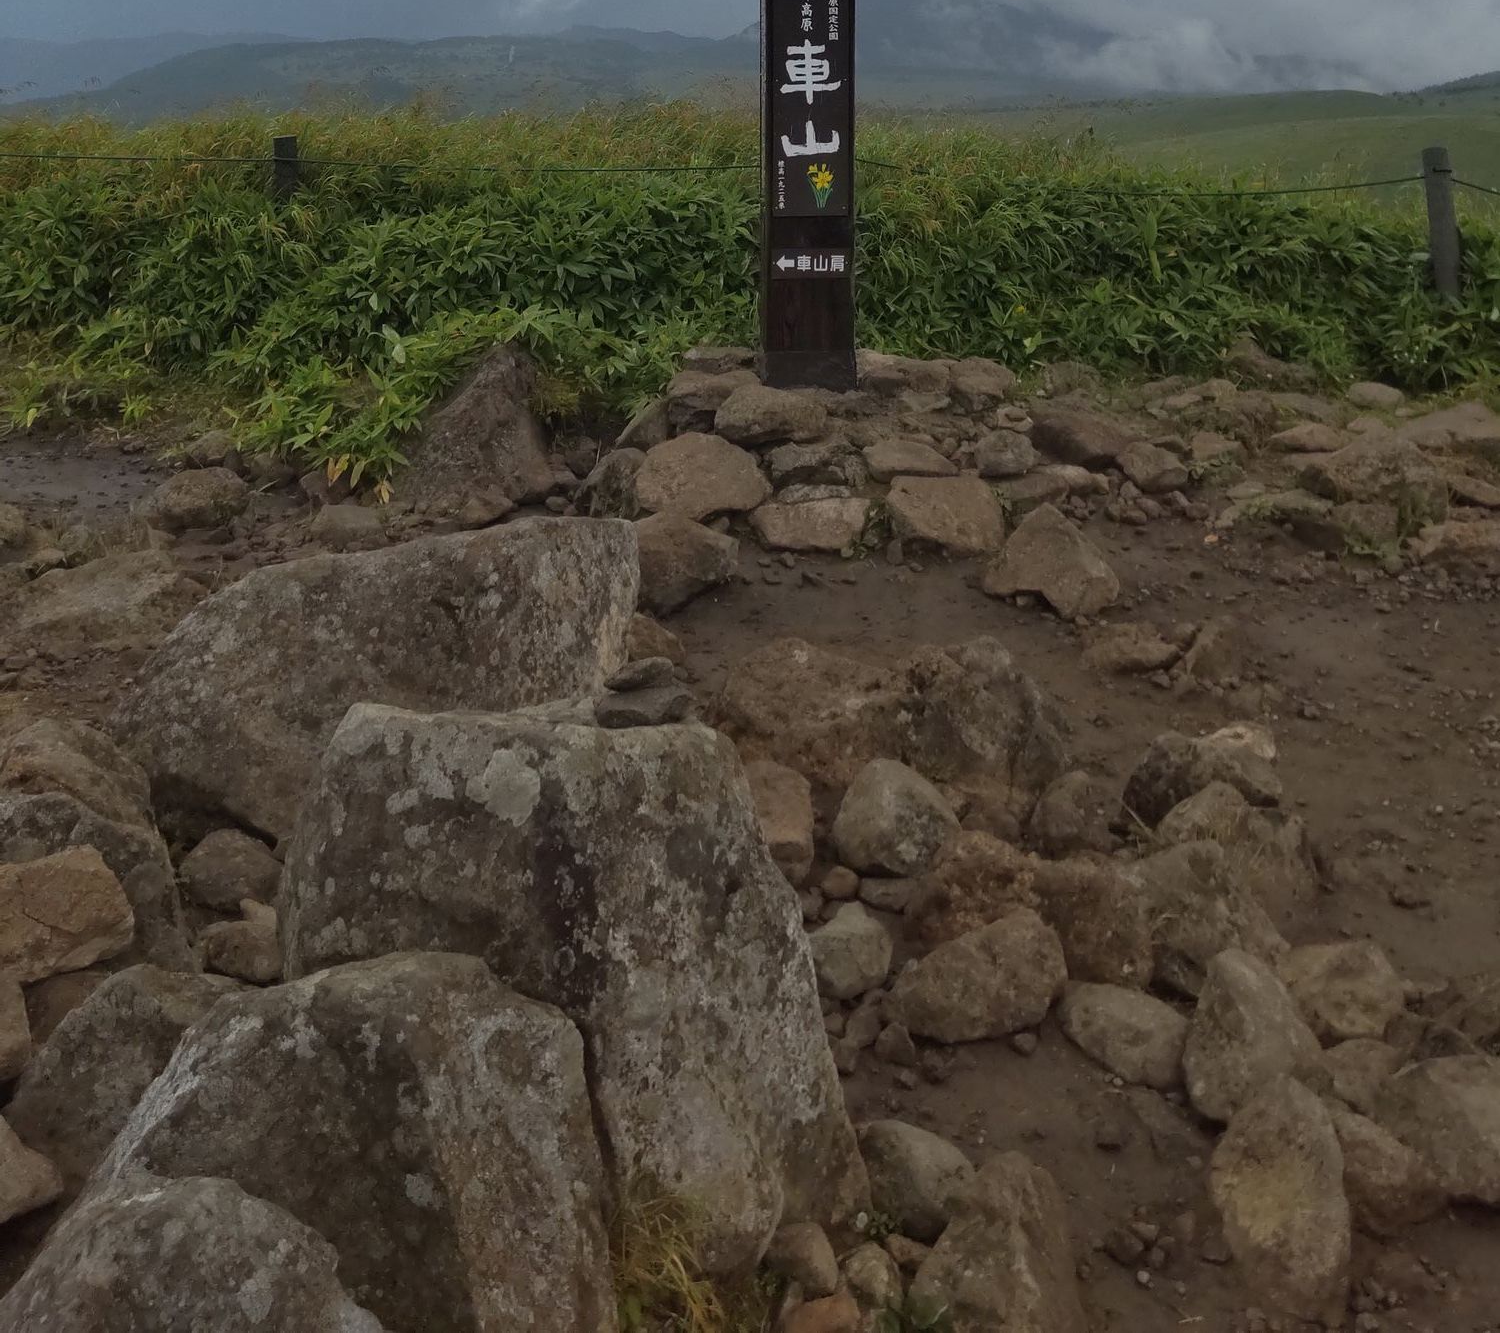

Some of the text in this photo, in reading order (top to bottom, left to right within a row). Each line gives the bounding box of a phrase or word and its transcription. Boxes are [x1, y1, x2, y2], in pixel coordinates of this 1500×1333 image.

[780, 39, 841, 157] 車山
[797, 255, 845, 272] 車山肩
